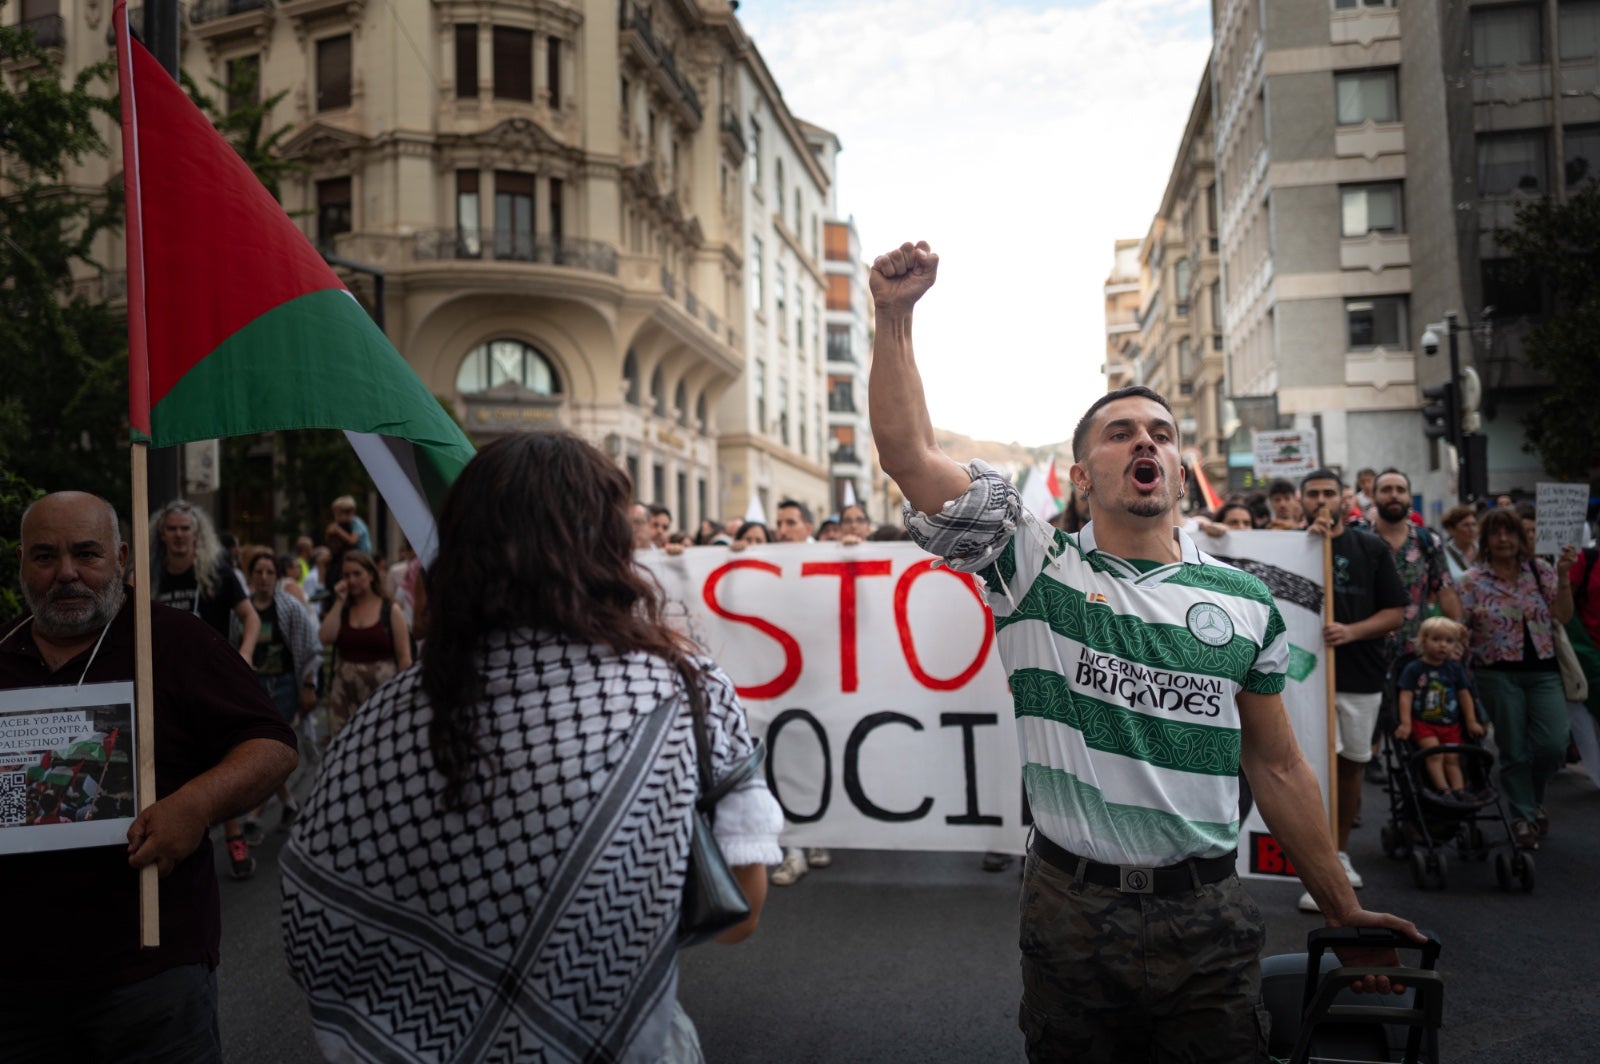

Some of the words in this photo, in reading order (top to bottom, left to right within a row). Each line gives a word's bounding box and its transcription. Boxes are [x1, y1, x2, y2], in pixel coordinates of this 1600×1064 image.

[703, 558, 1011, 700] STO
[1075, 662, 1221, 718] BRIGADES
[1080, 647, 1224, 695] INTERNATIONAL
[33, 716, 49, 725] YO
[52, 714, 82, 724] PARA
[42, 725, 89, 735] CONTRA
[0, 756, 38, 764] INOMBRE
[765, 708, 1032, 827] OCI
